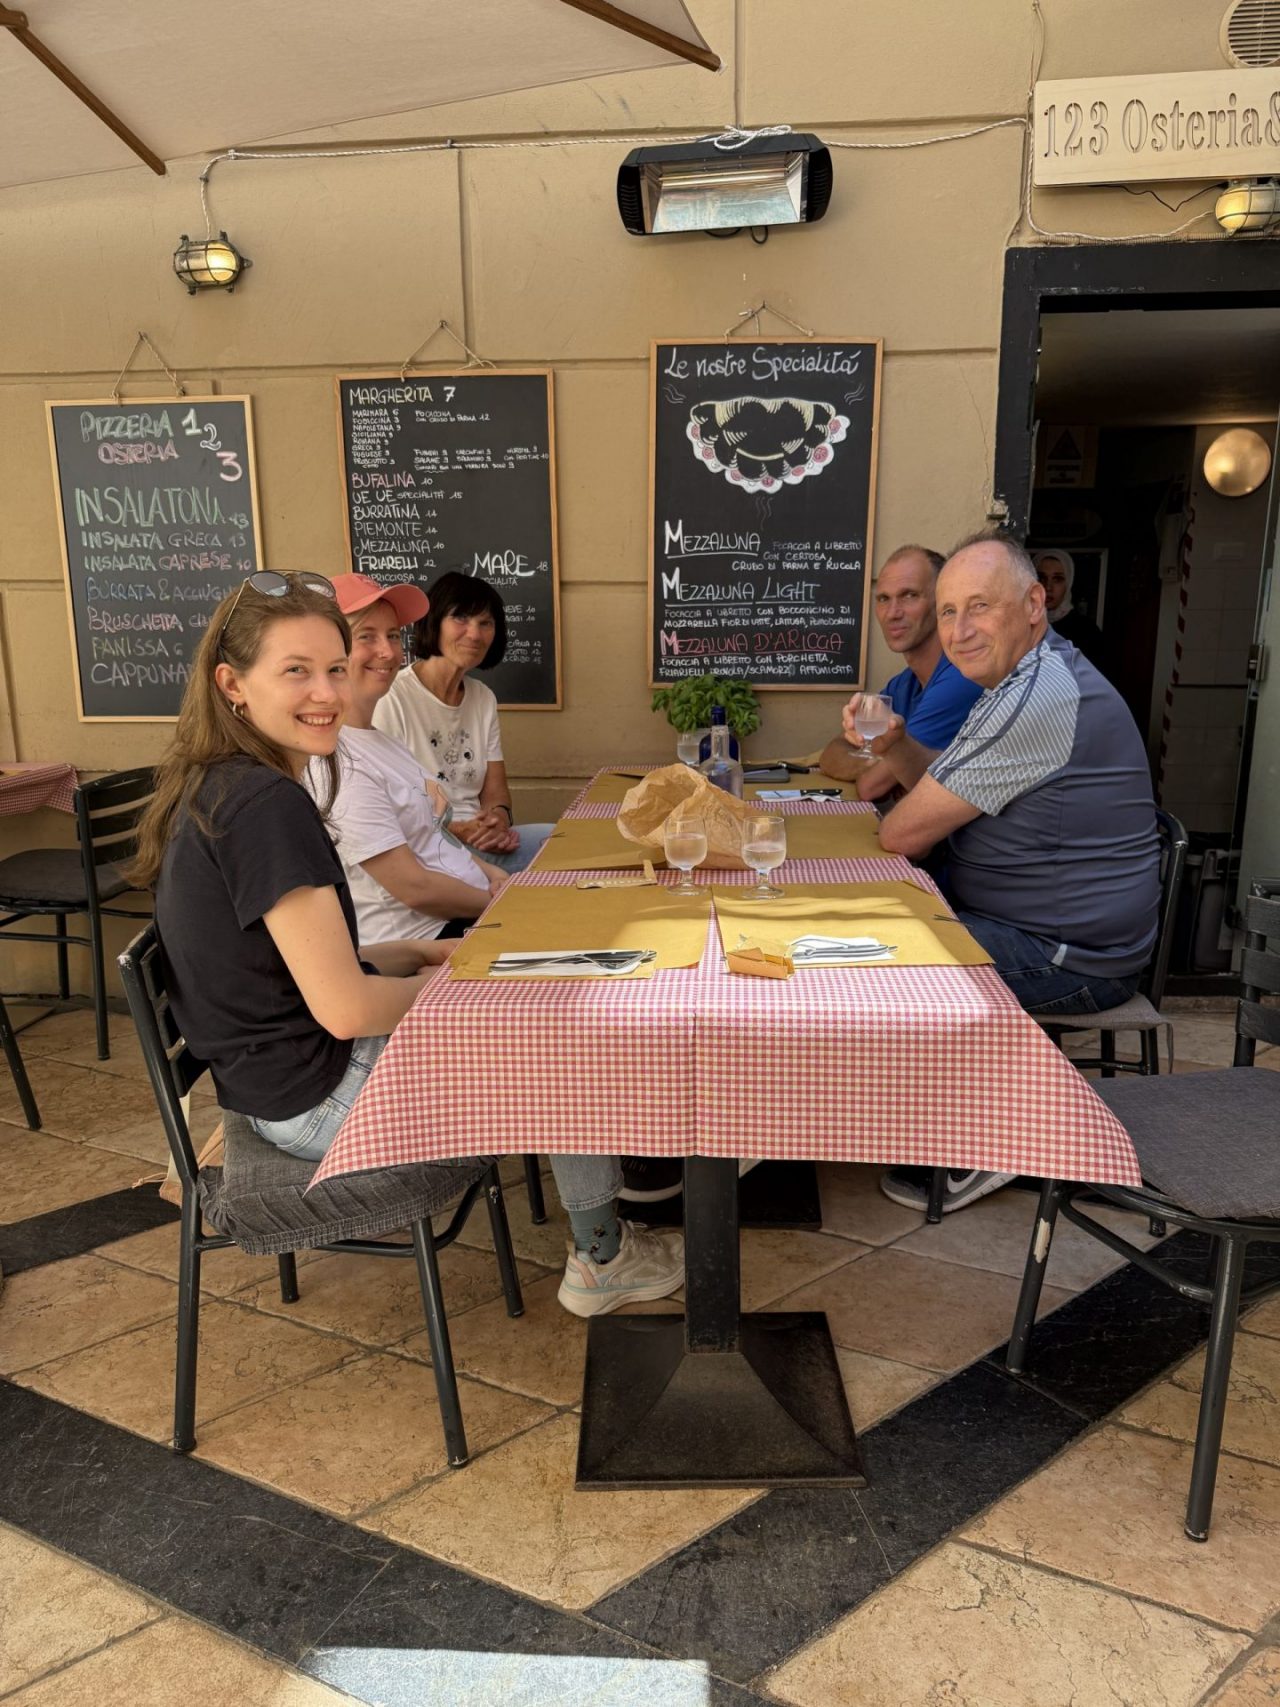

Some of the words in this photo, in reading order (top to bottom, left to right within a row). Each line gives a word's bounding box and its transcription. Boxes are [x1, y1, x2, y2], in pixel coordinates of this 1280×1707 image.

[1043, 101, 1109, 157] 123
[664, 347, 689, 379] Le
[697, 351, 747, 377] nostre
[350, 385, 433, 406] MARGHERITA
[443, 386, 456, 402] 7
[352, 408, 389, 418] MARINARA
[392, 408, 399, 416] 6
[480, 413, 491, 421] 12
[352, 424, 394, 432] NAPOLETANA
[80, 410, 174, 442] PIZZERIA
[182, 407, 202, 436] 1
[200, 422, 222, 451] 2
[217, 451, 243, 483] 3
[352, 437, 381, 445] ROMANA
[98, 440, 180, 465] OSTERIA
[351, 471, 416, 489] BUFALINA
[421, 477, 433, 485] 10
[449, 491, 464, 499] 15
[352, 503, 420, 521] BURRATINA
[353, 521, 423, 537] PIEMONTE
[664, 519, 761, 555] MEZZALUNA
[81, 531, 165, 552] INSALATA
[167, 529, 223, 548] GRECA
[353, 538, 431, 557] MEZZALUNA
[433, 542, 445, 550] 10
[772, 541, 811, 551] FOCACCIA
[814, 541, 821, 550] A
[84, 553, 157, 573] INSALATA
[158, 551, 232, 572] CAPRESE
[235, 558, 252, 572] 10
[359, 555, 419, 572] FRIARELLI
[424, 559, 437, 568] 12
[470, 549, 536, 577] MARE
[537, 561, 549, 572] 18
[763, 552, 780, 561] CON
[731, 561, 765, 570] CRUDO
[768, 562, 776, 570] DI
[782, 561, 809, 570] PARMA
[813, 562, 820, 570] E
[826, 561, 861, 571] RUCOLA
[418, 573, 428, 582] 10
[661, 567, 755, 602] MEZZALUNA
[762, 577, 821, 600] LIGHT
[86, 576, 156, 602] BURRATA
[157, 578, 170, 600] &
[86, 607, 184, 634] BRUSCHETTA
[664, 608, 702, 618] FOCACCIA
[706, 608, 713, 617] A
[756, 607, 775, 615] CON
[778, 605, 835, 615] BOCCONCINO
[840, 606, 850, 614] DI
[664, 618, 718, 629] MOZZARELLA
[809, 617, 855, 626] POMODORINI
[91, 634, 170, 661] PANISSA
[660, 629, 749, 656] MEZZALUNA
[661, 656, 700, 667] FOCACCIA
[703, 656, 710, 665] A
[713, 655, 752, 665] LIBRETTO
[755, 654, 773, 664] CON
